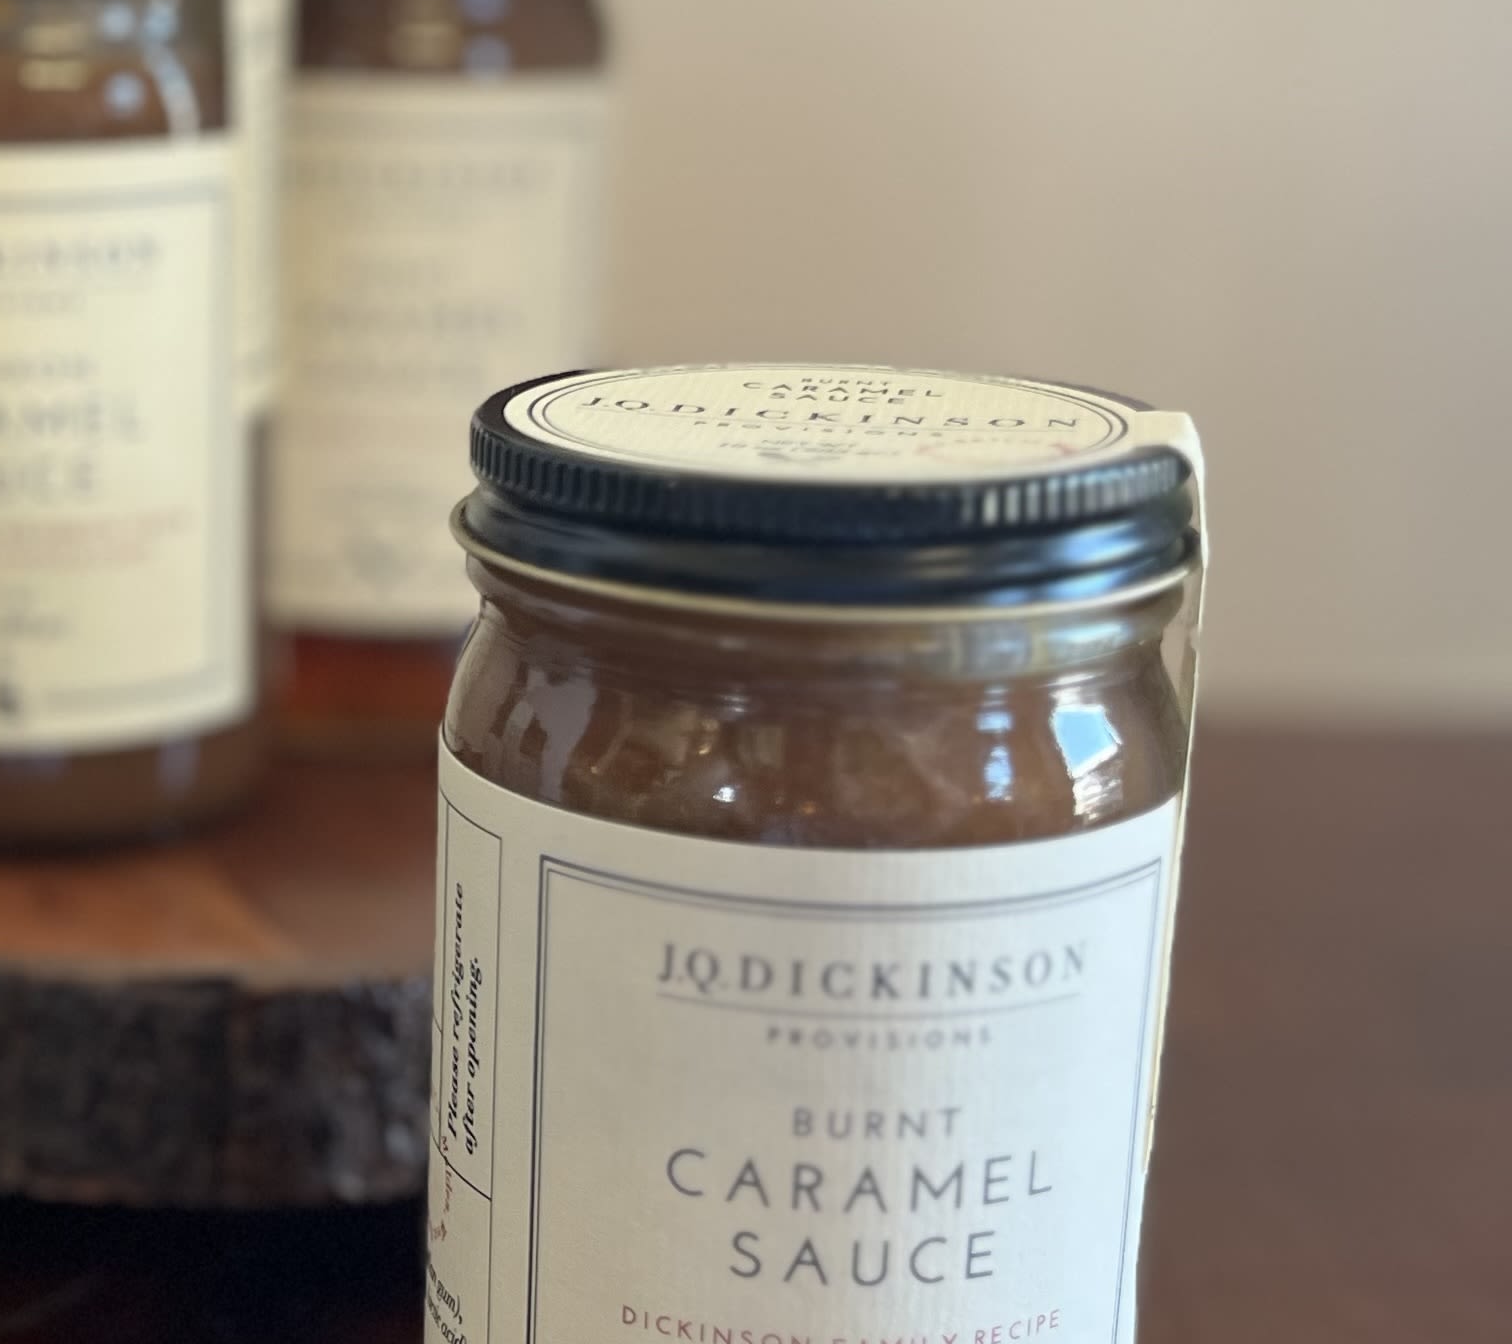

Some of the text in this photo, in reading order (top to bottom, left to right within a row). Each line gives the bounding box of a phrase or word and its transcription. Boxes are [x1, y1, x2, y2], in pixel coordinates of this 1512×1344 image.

[743, 381, 944, 398] CARAMEL
[769, 393, 907, 404] SAUCE
[446, 882, 465, 1140] Please refrigerate
[462, 957, 483, 1156] after opening.
[766, 1026, 993, 1050] PROVISIONS
[793, 1106, 962, 1141] BURNT
[666, 1148, 1053, 1214] CARAMEL
[728, 1230, 997, 1287] SAUCE
